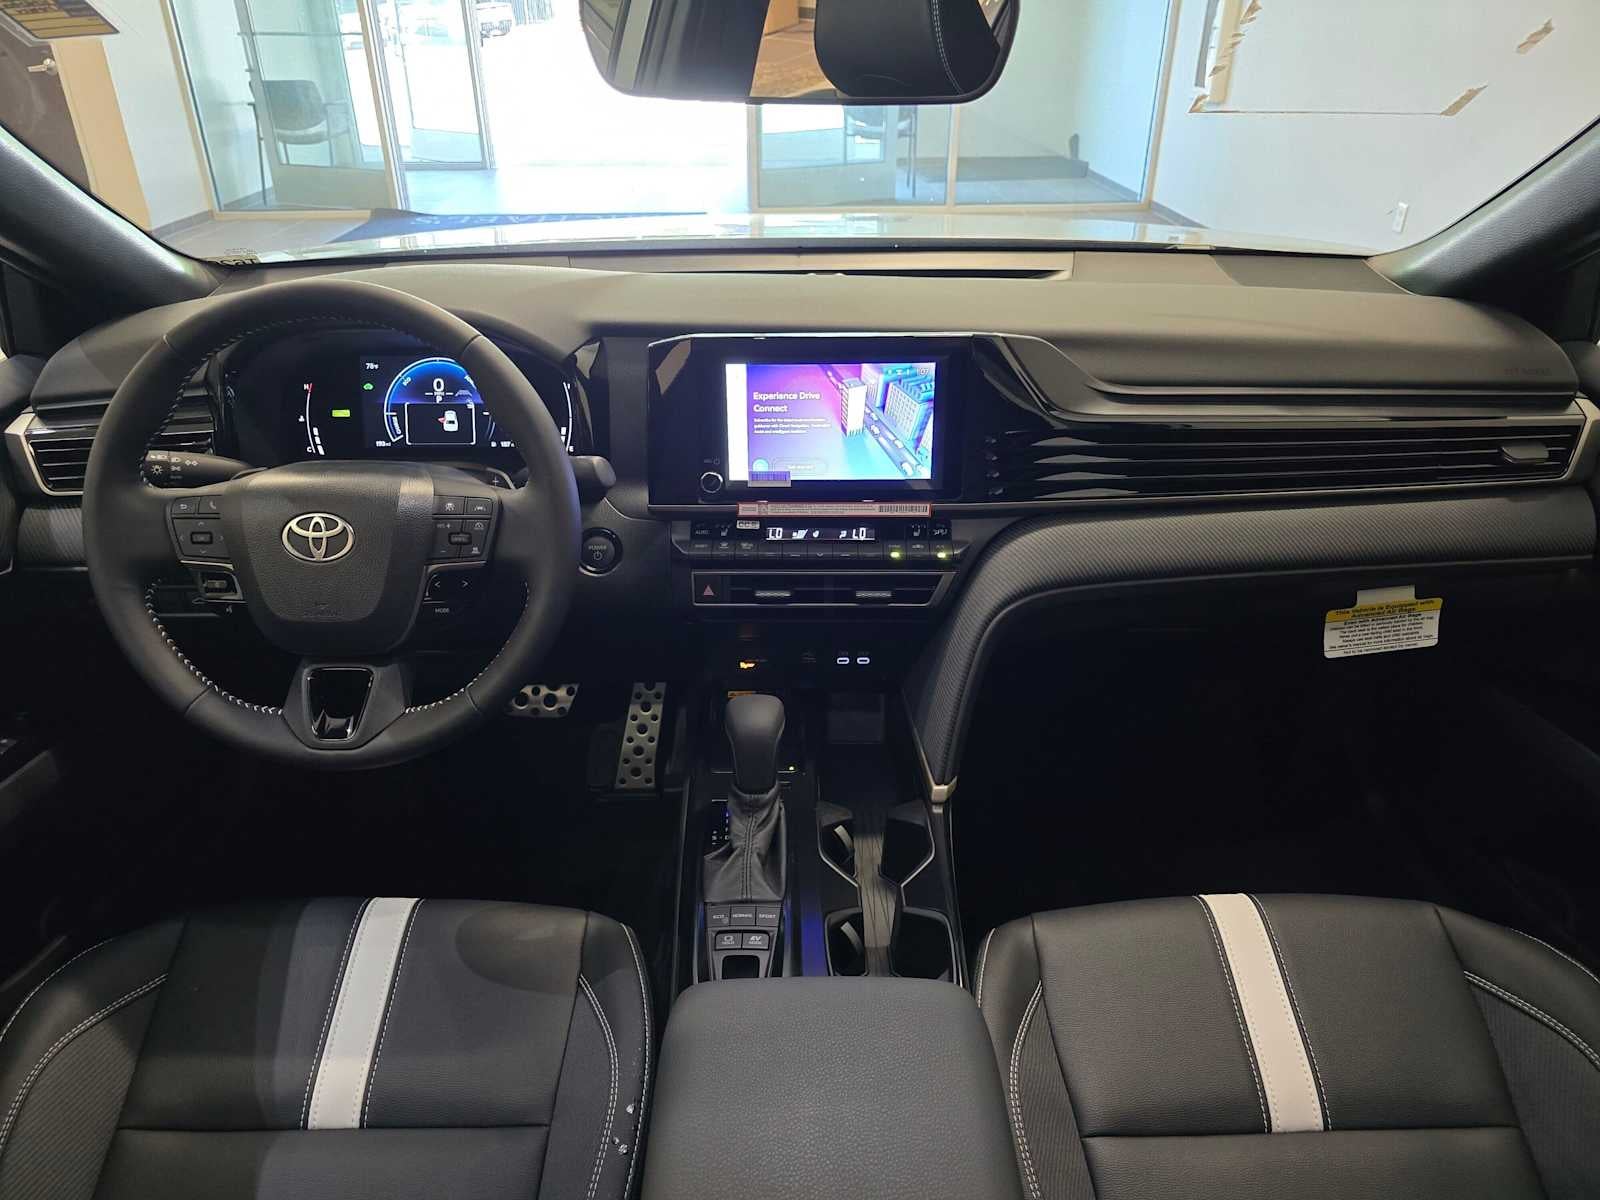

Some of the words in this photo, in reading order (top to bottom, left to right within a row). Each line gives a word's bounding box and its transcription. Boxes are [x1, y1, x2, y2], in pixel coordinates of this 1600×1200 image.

[753, 392, 798, 401] Experience
[799, 392, 821, 400] Drive
[753, 404, 788, 412] Connect
